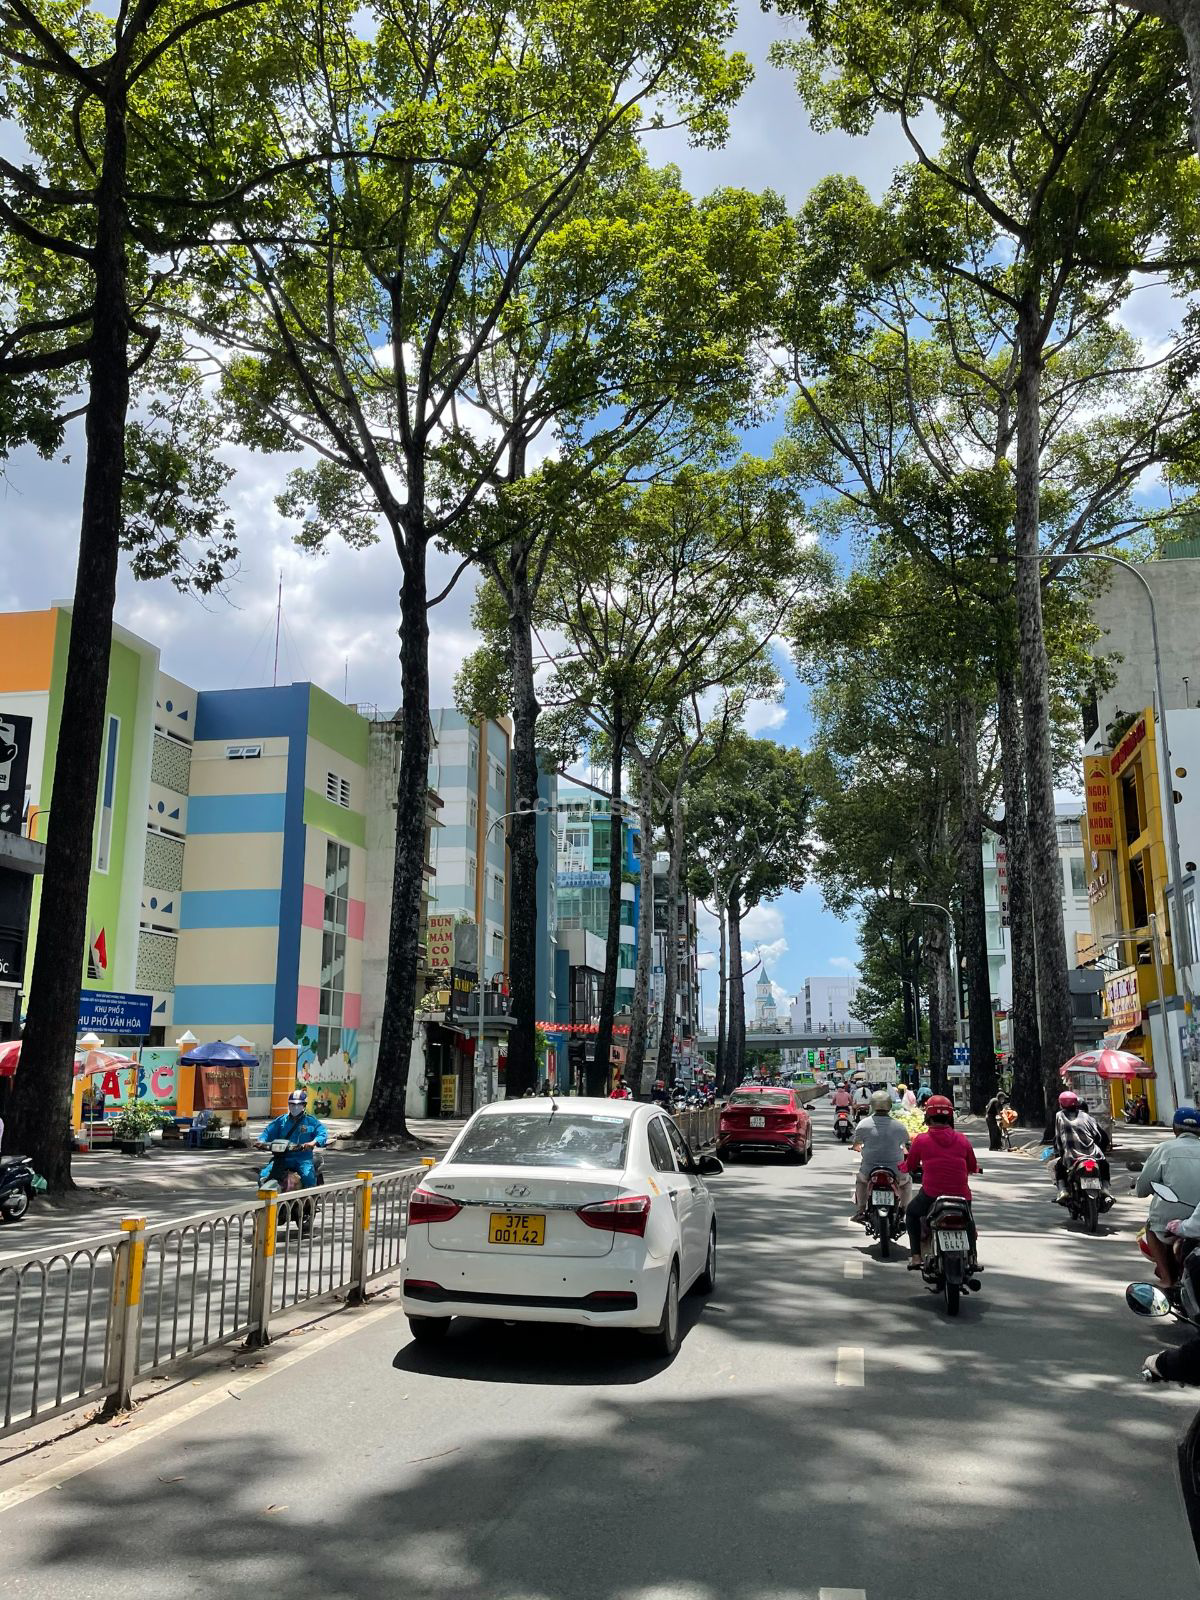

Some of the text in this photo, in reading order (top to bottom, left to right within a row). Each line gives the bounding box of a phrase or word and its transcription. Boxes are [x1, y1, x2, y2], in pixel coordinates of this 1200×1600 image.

[1088, 785, 1110, 799] NGOẠI
[1090, 816, 1113, 829] KHÔNG
[1094, 833, 1111, 845] GIAN
[431, 943, 450, 955] CÔ
[431, 957, 450, 967] BA
[94, 1005, 107, 1013] KHU
[107, 1005, 120, 1014] PHỐ
[78, 1015, 90, 1026] HU
[91, 1013, 108, 1026] PHỐ
[109, 1016, 125, 1027] VĂN
[101, 1070, 121, 1099] A
[151, 1066, 174, 1098] C
[505, 1215, 529, 1229] 37E
[495, 1229, 539, 1244] 001.42
